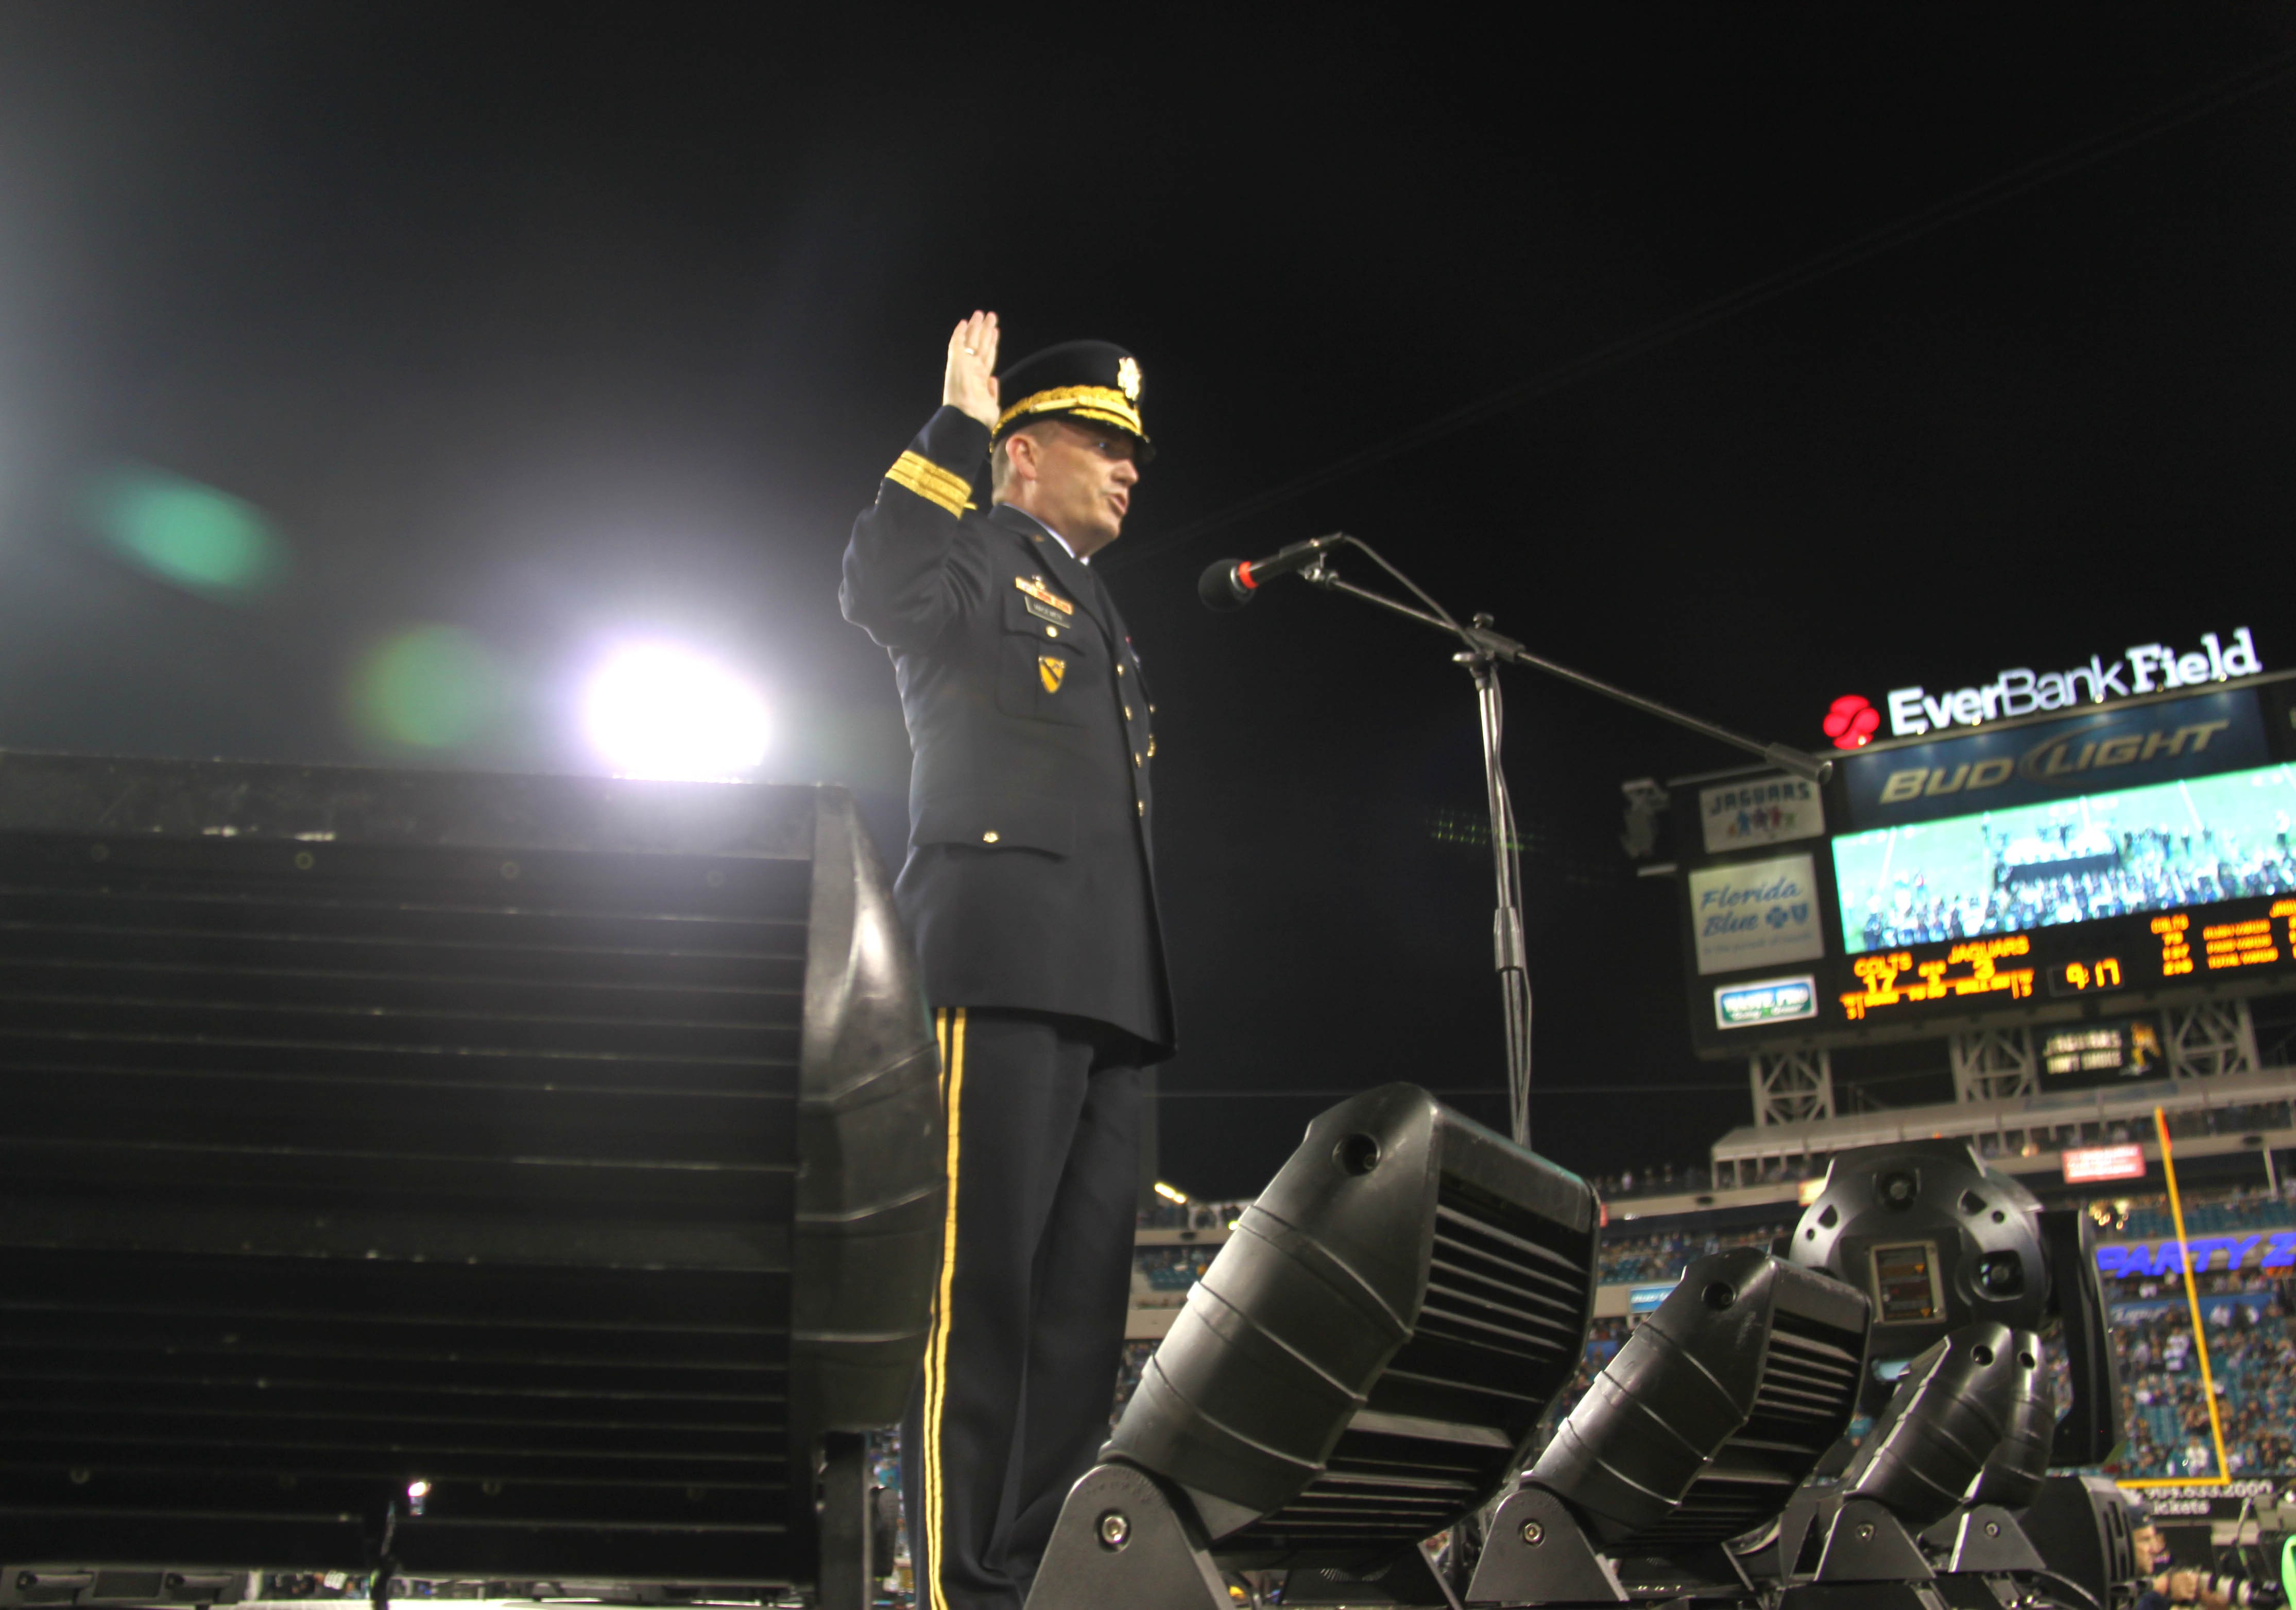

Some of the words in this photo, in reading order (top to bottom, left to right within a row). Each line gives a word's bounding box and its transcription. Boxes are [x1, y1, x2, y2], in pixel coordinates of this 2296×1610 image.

[1887, 655, 2129, 735] EverBank
[2126, 627, 2261, 693] Field
[1880, 758, 2013, 803] BUD
[2045, 720, 2230, 774] LIGHT
[1709, 781, 1811, 815] JAGUARS
[1700, 876, 1800, 910] Florida
[1702, 911, 1758, 938] Blue
[1854, 951, 1913, 977] COLTS
[1948, 934, 2030, 964] JAGUARS
[1863, 971, 1898, 995] 17
[1973, 957, 1995, 979] 3
[2096, 1235, 2261, 1279] PARTY
